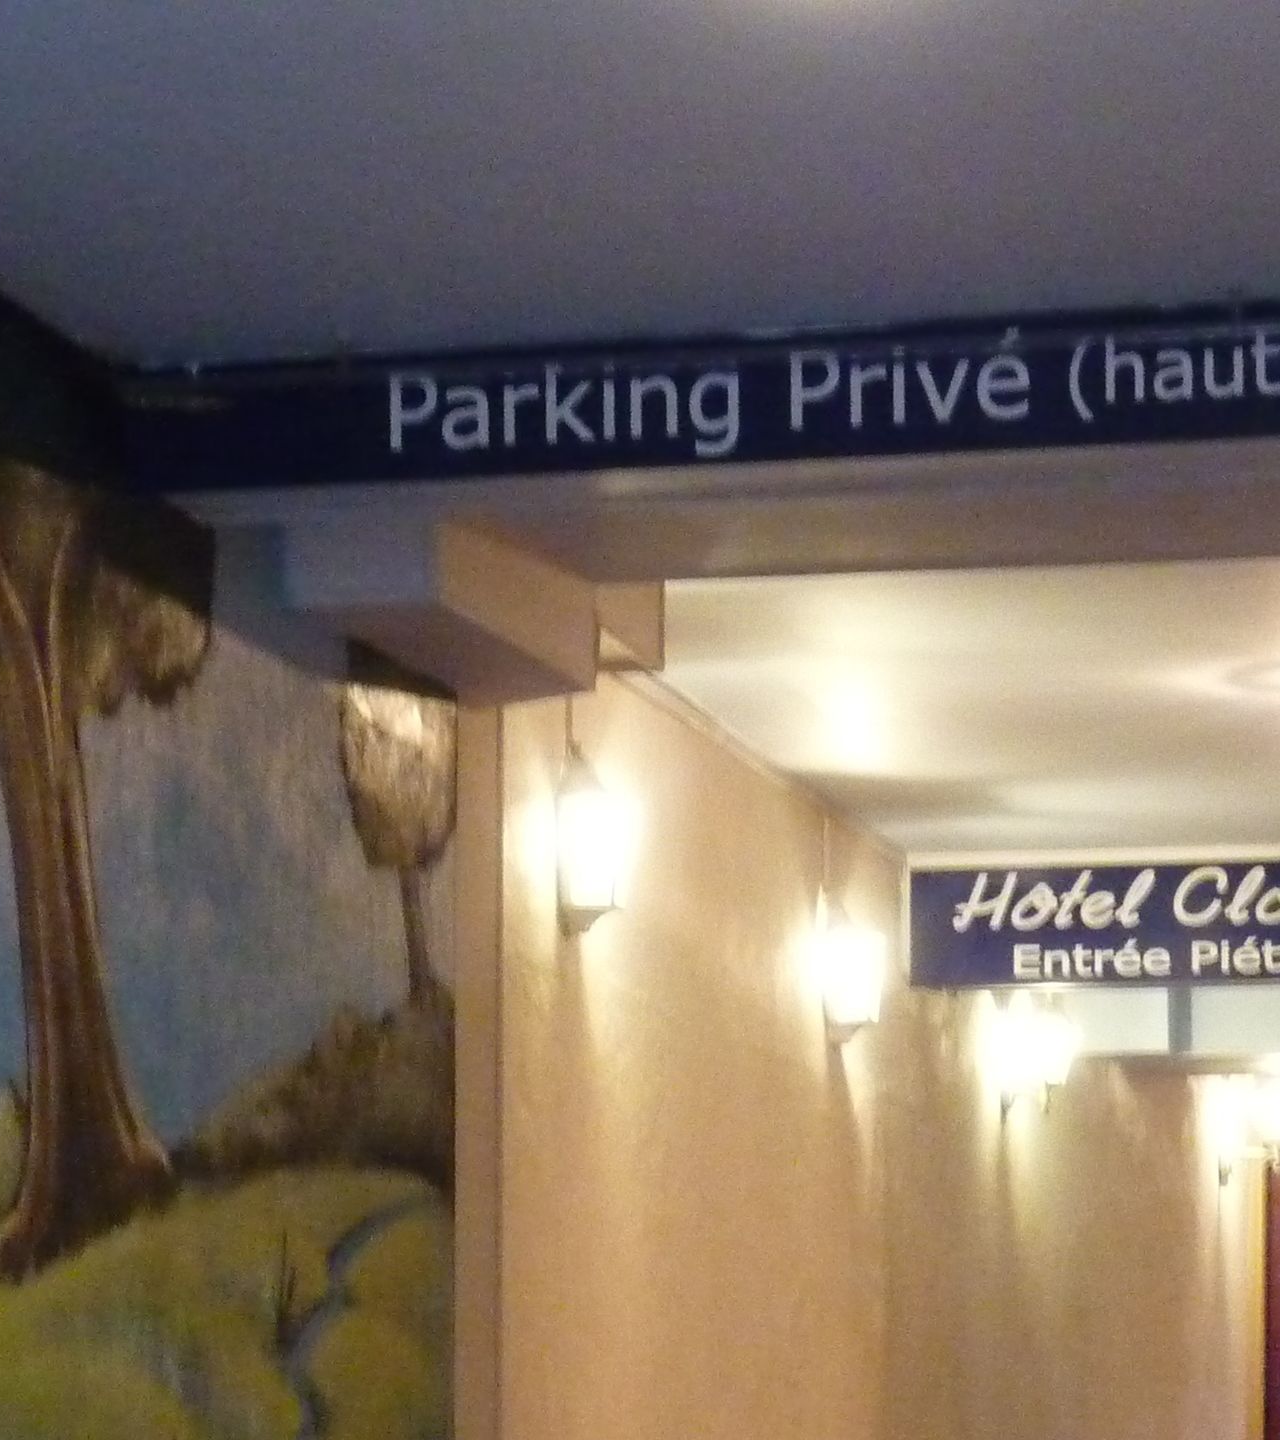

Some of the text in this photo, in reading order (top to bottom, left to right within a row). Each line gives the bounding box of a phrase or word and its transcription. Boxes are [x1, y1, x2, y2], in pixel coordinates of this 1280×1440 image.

[387, 363, 741, 456] Parking
[788, 324, 1031, 431] Privé
[951, 868, 1156, 932] Hôtel
[1013, 937, 1172, 979] Entrée
